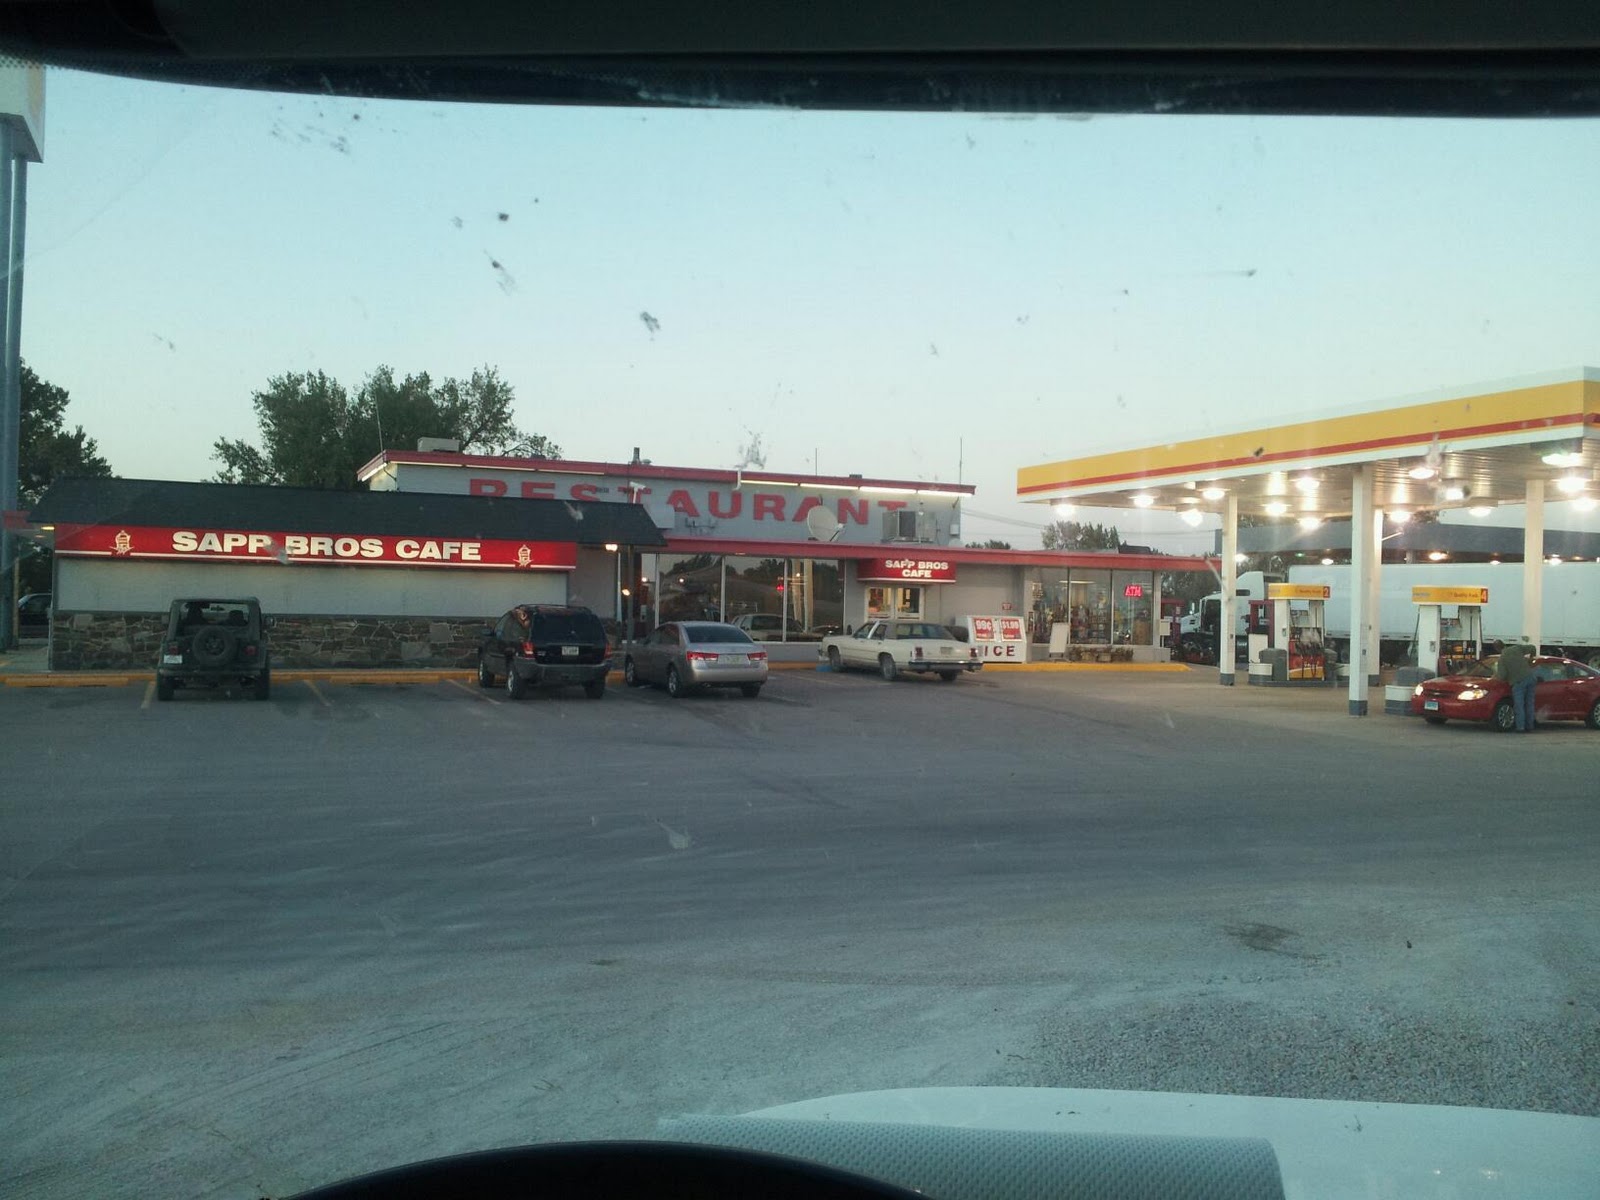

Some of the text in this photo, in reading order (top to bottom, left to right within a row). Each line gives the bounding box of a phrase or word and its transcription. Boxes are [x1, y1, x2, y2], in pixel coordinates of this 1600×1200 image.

[172, 531, 482, 561] SAPP BROS CAFE
[918, 561, 949, 570] BROS
[902, 569, 932, 578] CAFE
[1125, 585, 1142, 597] ATM
[1323, 587, 1329, 597] 2
[1481, 589, 1487, 603] 4
[984, 645, 1016, 657] ICE
